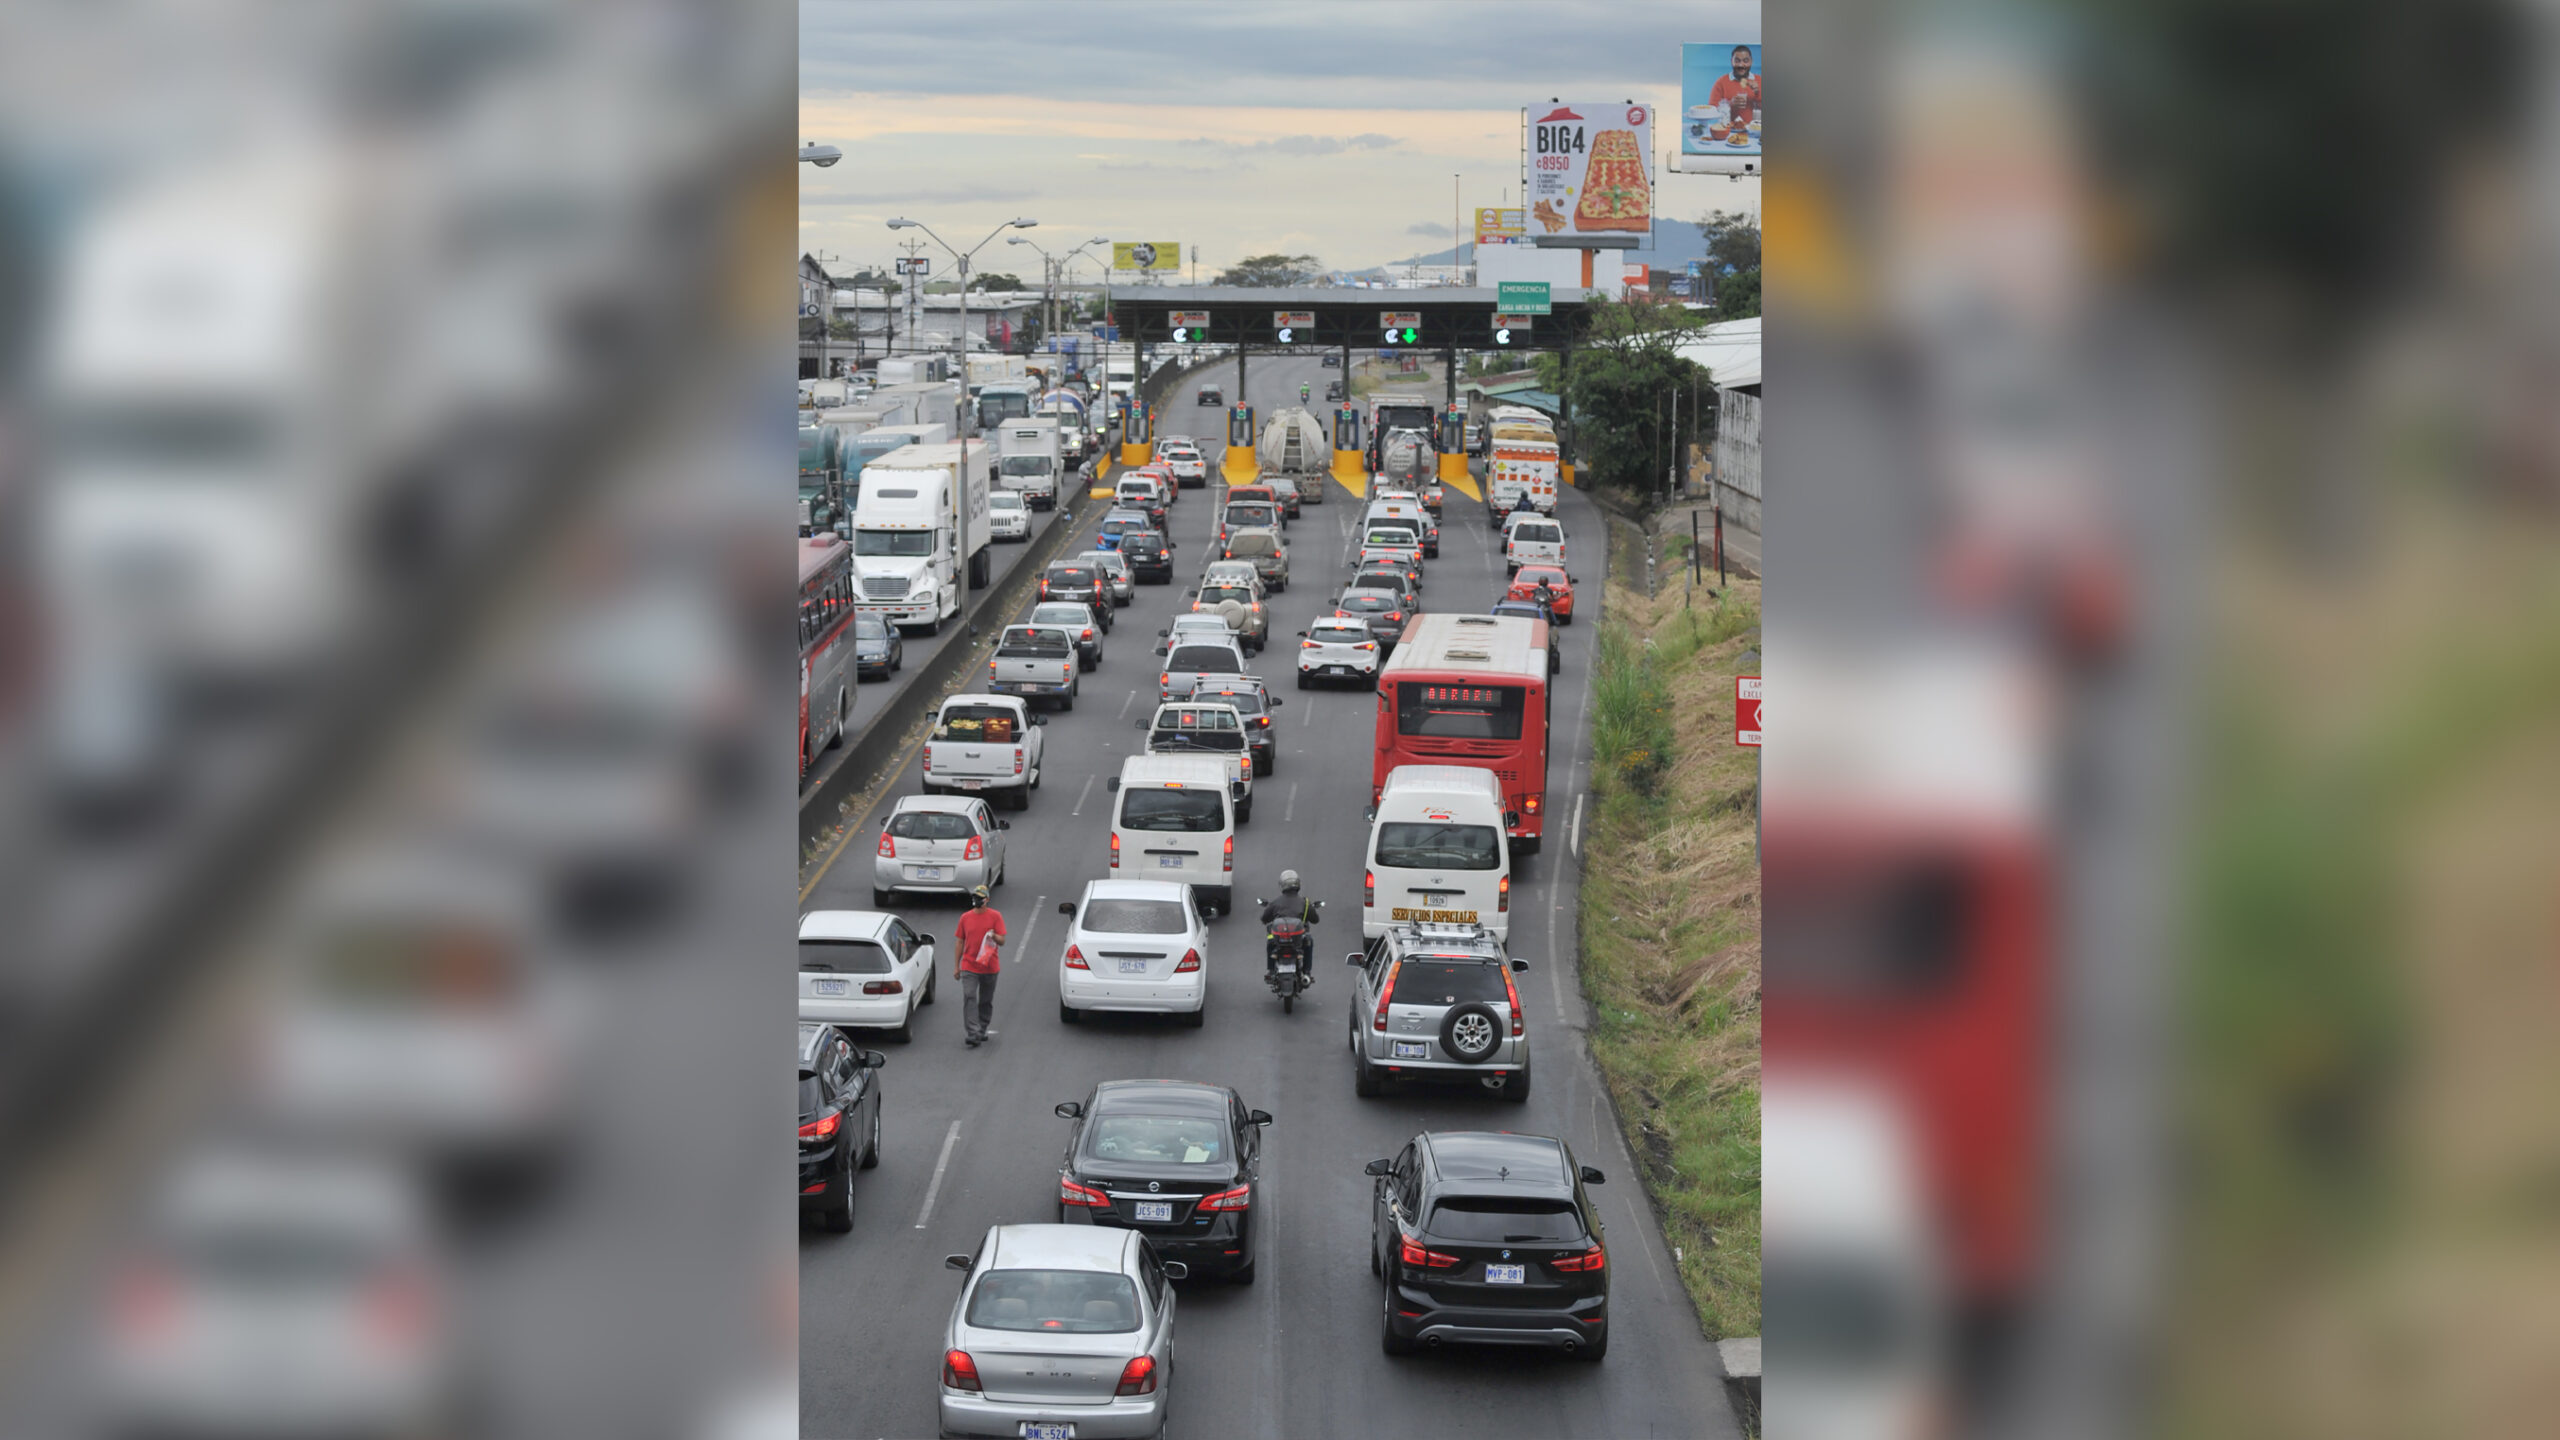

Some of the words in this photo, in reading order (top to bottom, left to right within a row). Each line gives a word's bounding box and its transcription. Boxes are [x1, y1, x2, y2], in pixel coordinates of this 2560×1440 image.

[1537, 125, 1585, 154] BIG4
[1502, 285, 1547, 293] EMERGENCIA
[1391, 907, 1431, 921] SERVICIOS
[1432, 909, 1478, 924] ESPECIALES
[1137, 1206, 1170, 1217] JCS-091
[1027, 1428, 1067, 1440] BNL-524
